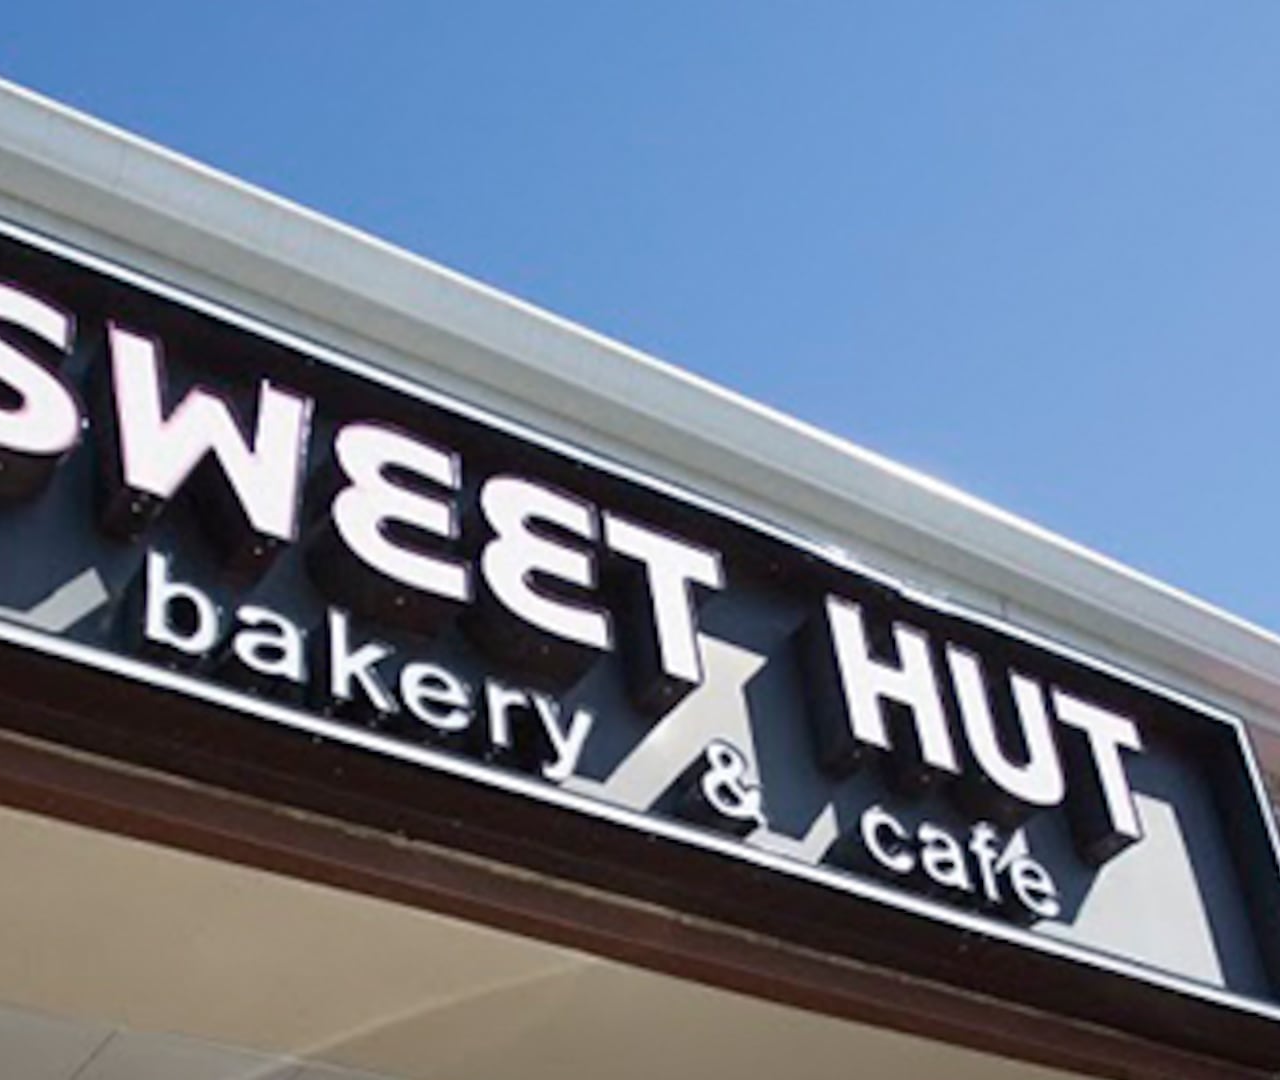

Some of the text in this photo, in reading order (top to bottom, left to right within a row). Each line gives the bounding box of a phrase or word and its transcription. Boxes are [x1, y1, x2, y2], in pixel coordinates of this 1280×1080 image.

[144, 550, 1061, 917] bakery & café
[825, 595, 1144, 842] HUT
